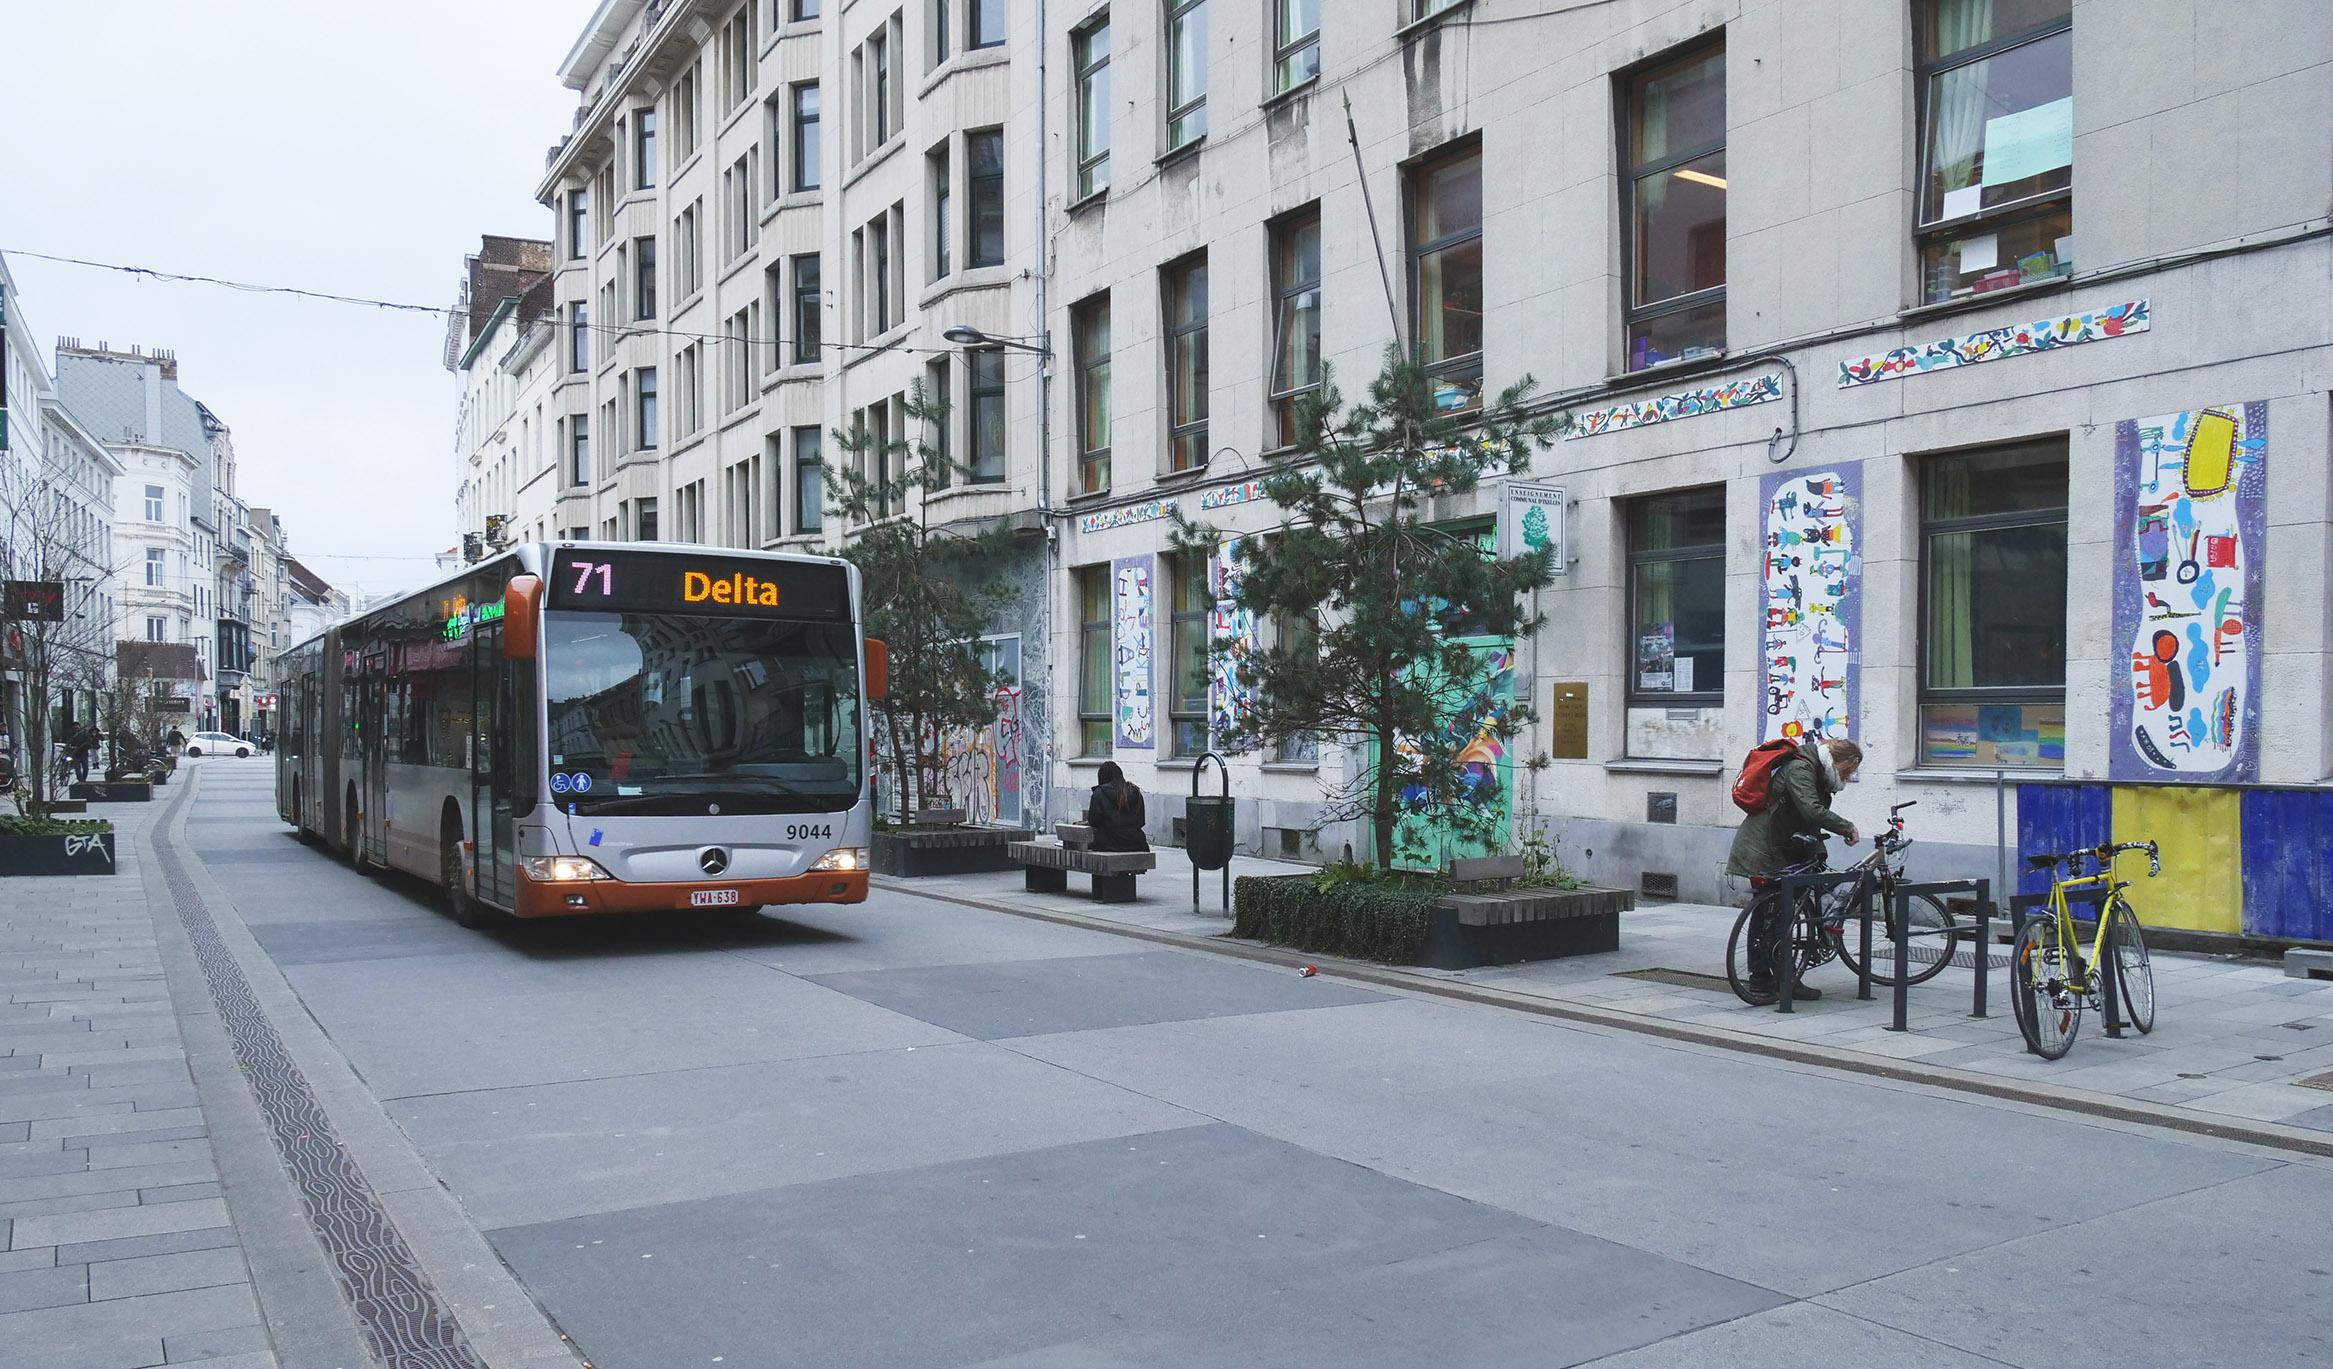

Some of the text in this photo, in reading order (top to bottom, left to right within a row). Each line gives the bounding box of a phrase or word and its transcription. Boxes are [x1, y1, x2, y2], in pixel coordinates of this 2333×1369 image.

[1510, 490, 1561, 499] ENSEIGNEMENT
[571, 562, 779, 606] 71 Delta
[786, 824, 832, 840] 9044
[65, 832, 110, 863] GTA
